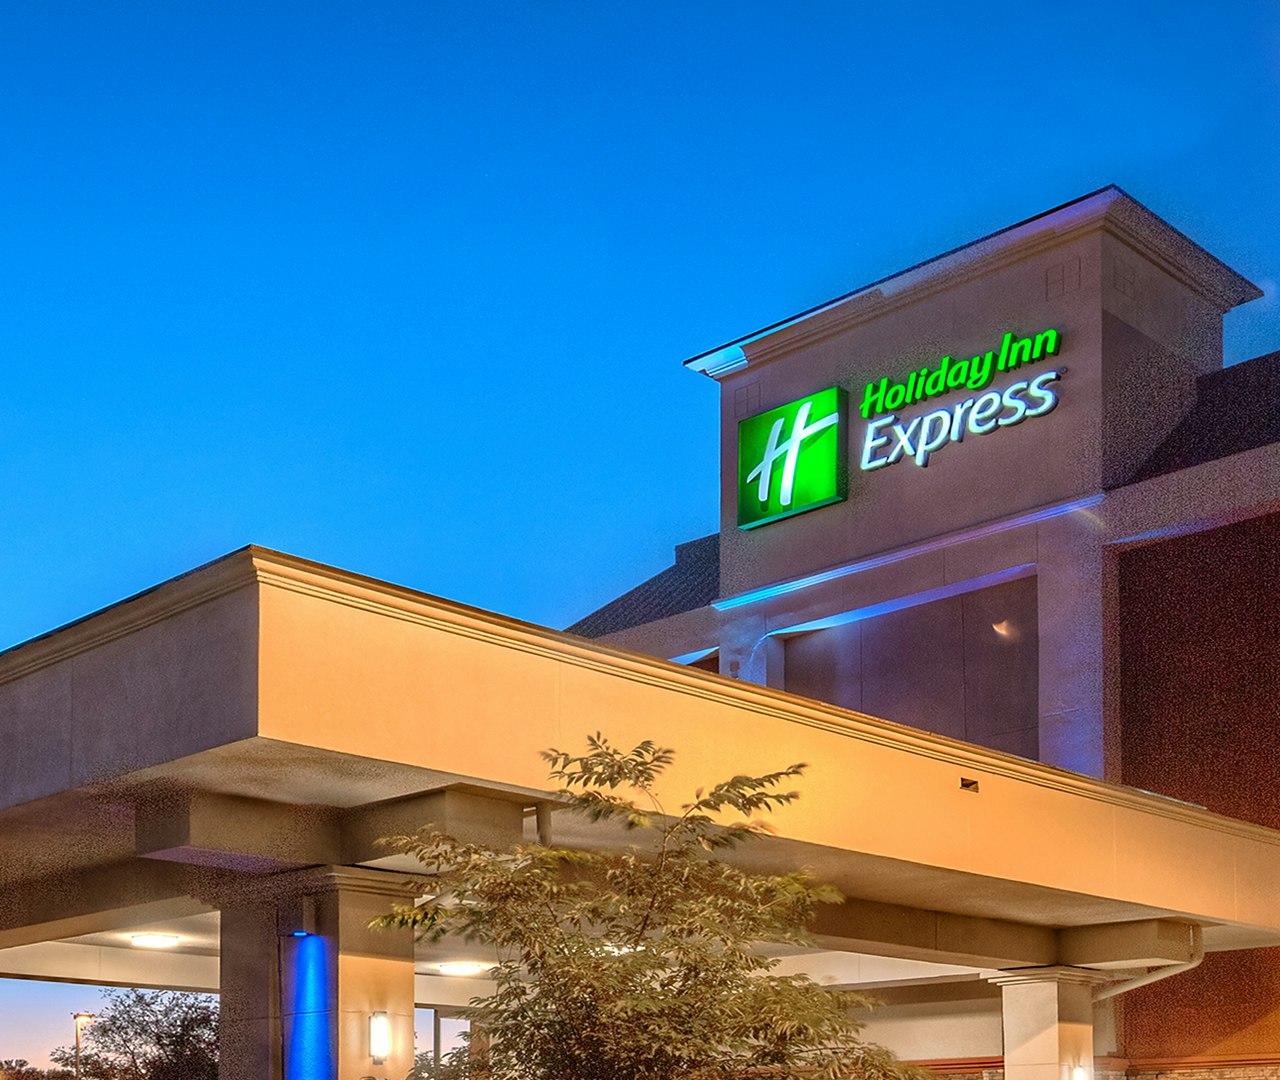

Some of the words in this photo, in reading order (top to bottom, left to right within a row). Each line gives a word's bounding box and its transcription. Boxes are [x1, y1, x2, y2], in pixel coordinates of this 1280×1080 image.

[859, 350, 993, 419] Holiday
[996, 328, 1061, 372] Inn
[860, 370, 1060, 471] Express
